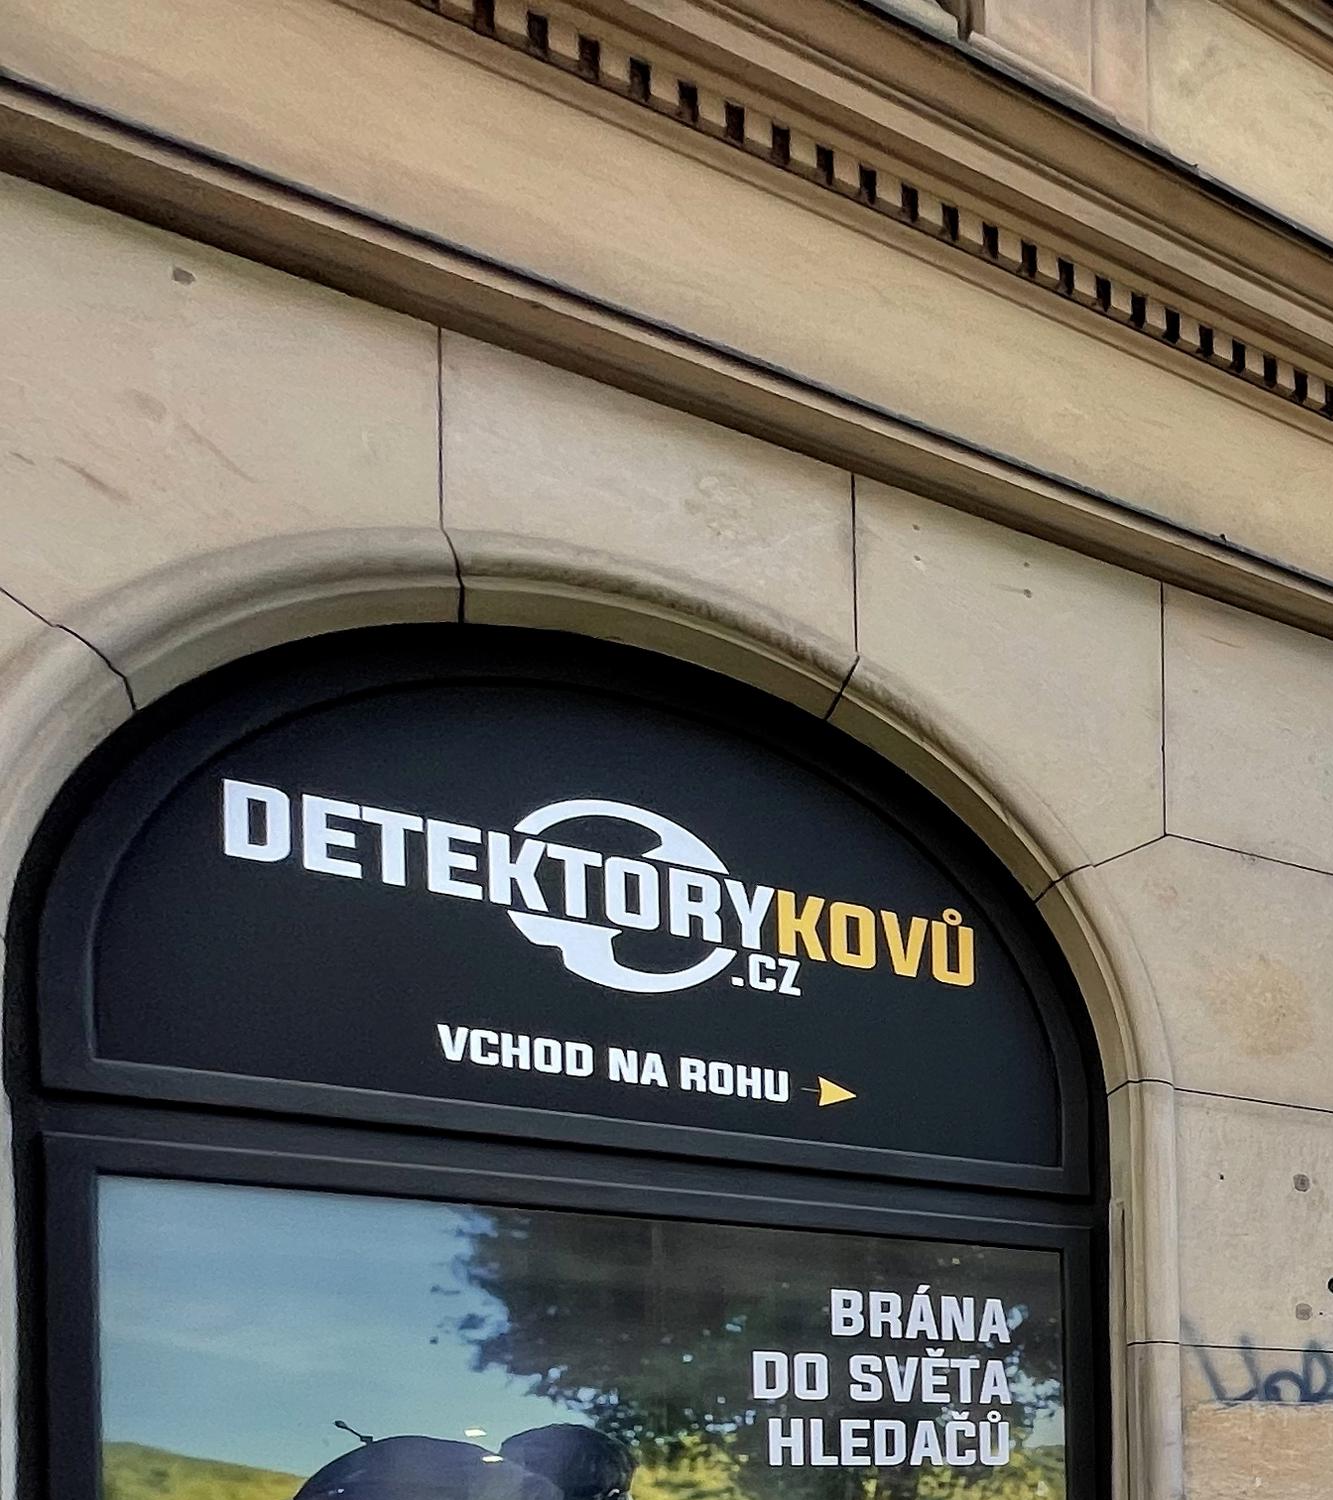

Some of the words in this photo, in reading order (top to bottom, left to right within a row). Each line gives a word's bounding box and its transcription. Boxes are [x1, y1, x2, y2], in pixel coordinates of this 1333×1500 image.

[731, 952, 801, 996] .CZ
[437, 1023, 593, 1077] VCHOD
[608, 1047, 669, 1087] NA
[680, 1057, 790, 1102] ROHU
[830, 1284, 1011, 1343] BRÁNA
[752, 1351, 829, 1400] DO
[850, 1347, 1012, 1404] SVĚTA
[768, 1410, 1010, 1466] HLEDAČŮ
